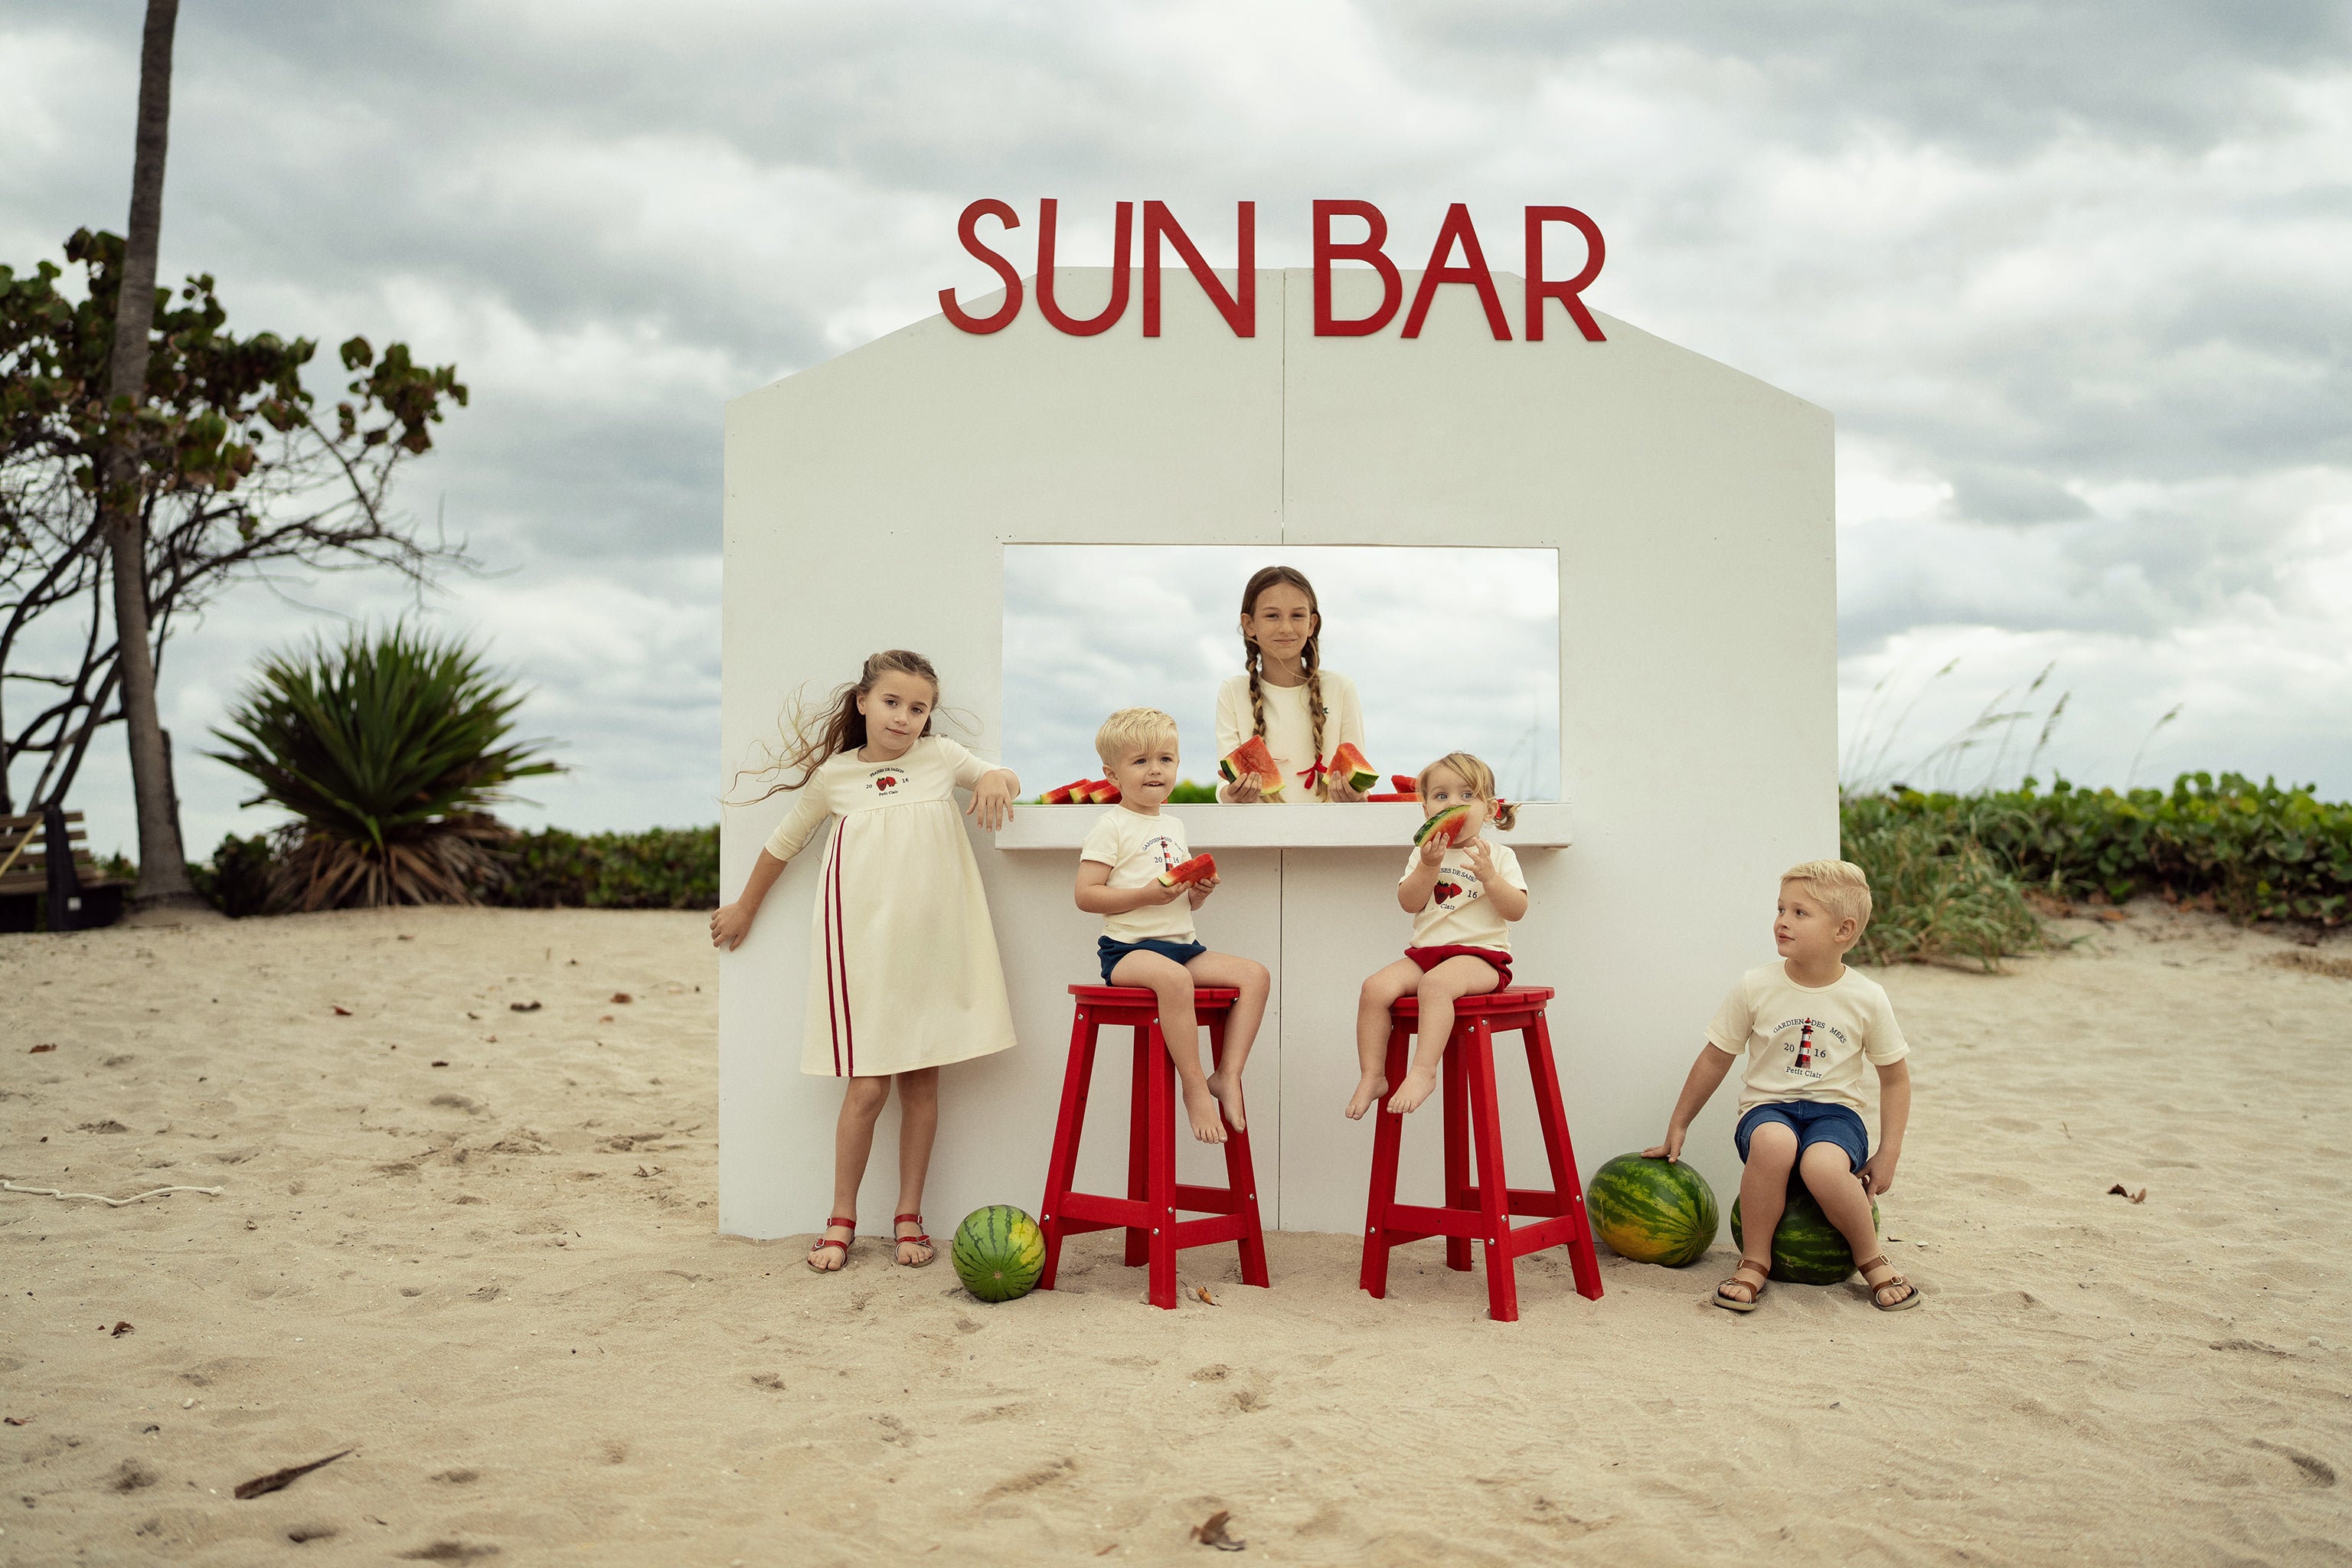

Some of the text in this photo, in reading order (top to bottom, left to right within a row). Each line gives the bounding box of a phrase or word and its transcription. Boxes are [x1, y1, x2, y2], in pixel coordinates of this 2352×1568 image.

[939, 198, 1607, 341] SUN BAR
[1773, 1019, 1847, 1044] GARDIEN DES MERS
[1784, 1042, 1826, 1058] 20 16
[1786, 1066, 1822, 1079] Petit Clair
